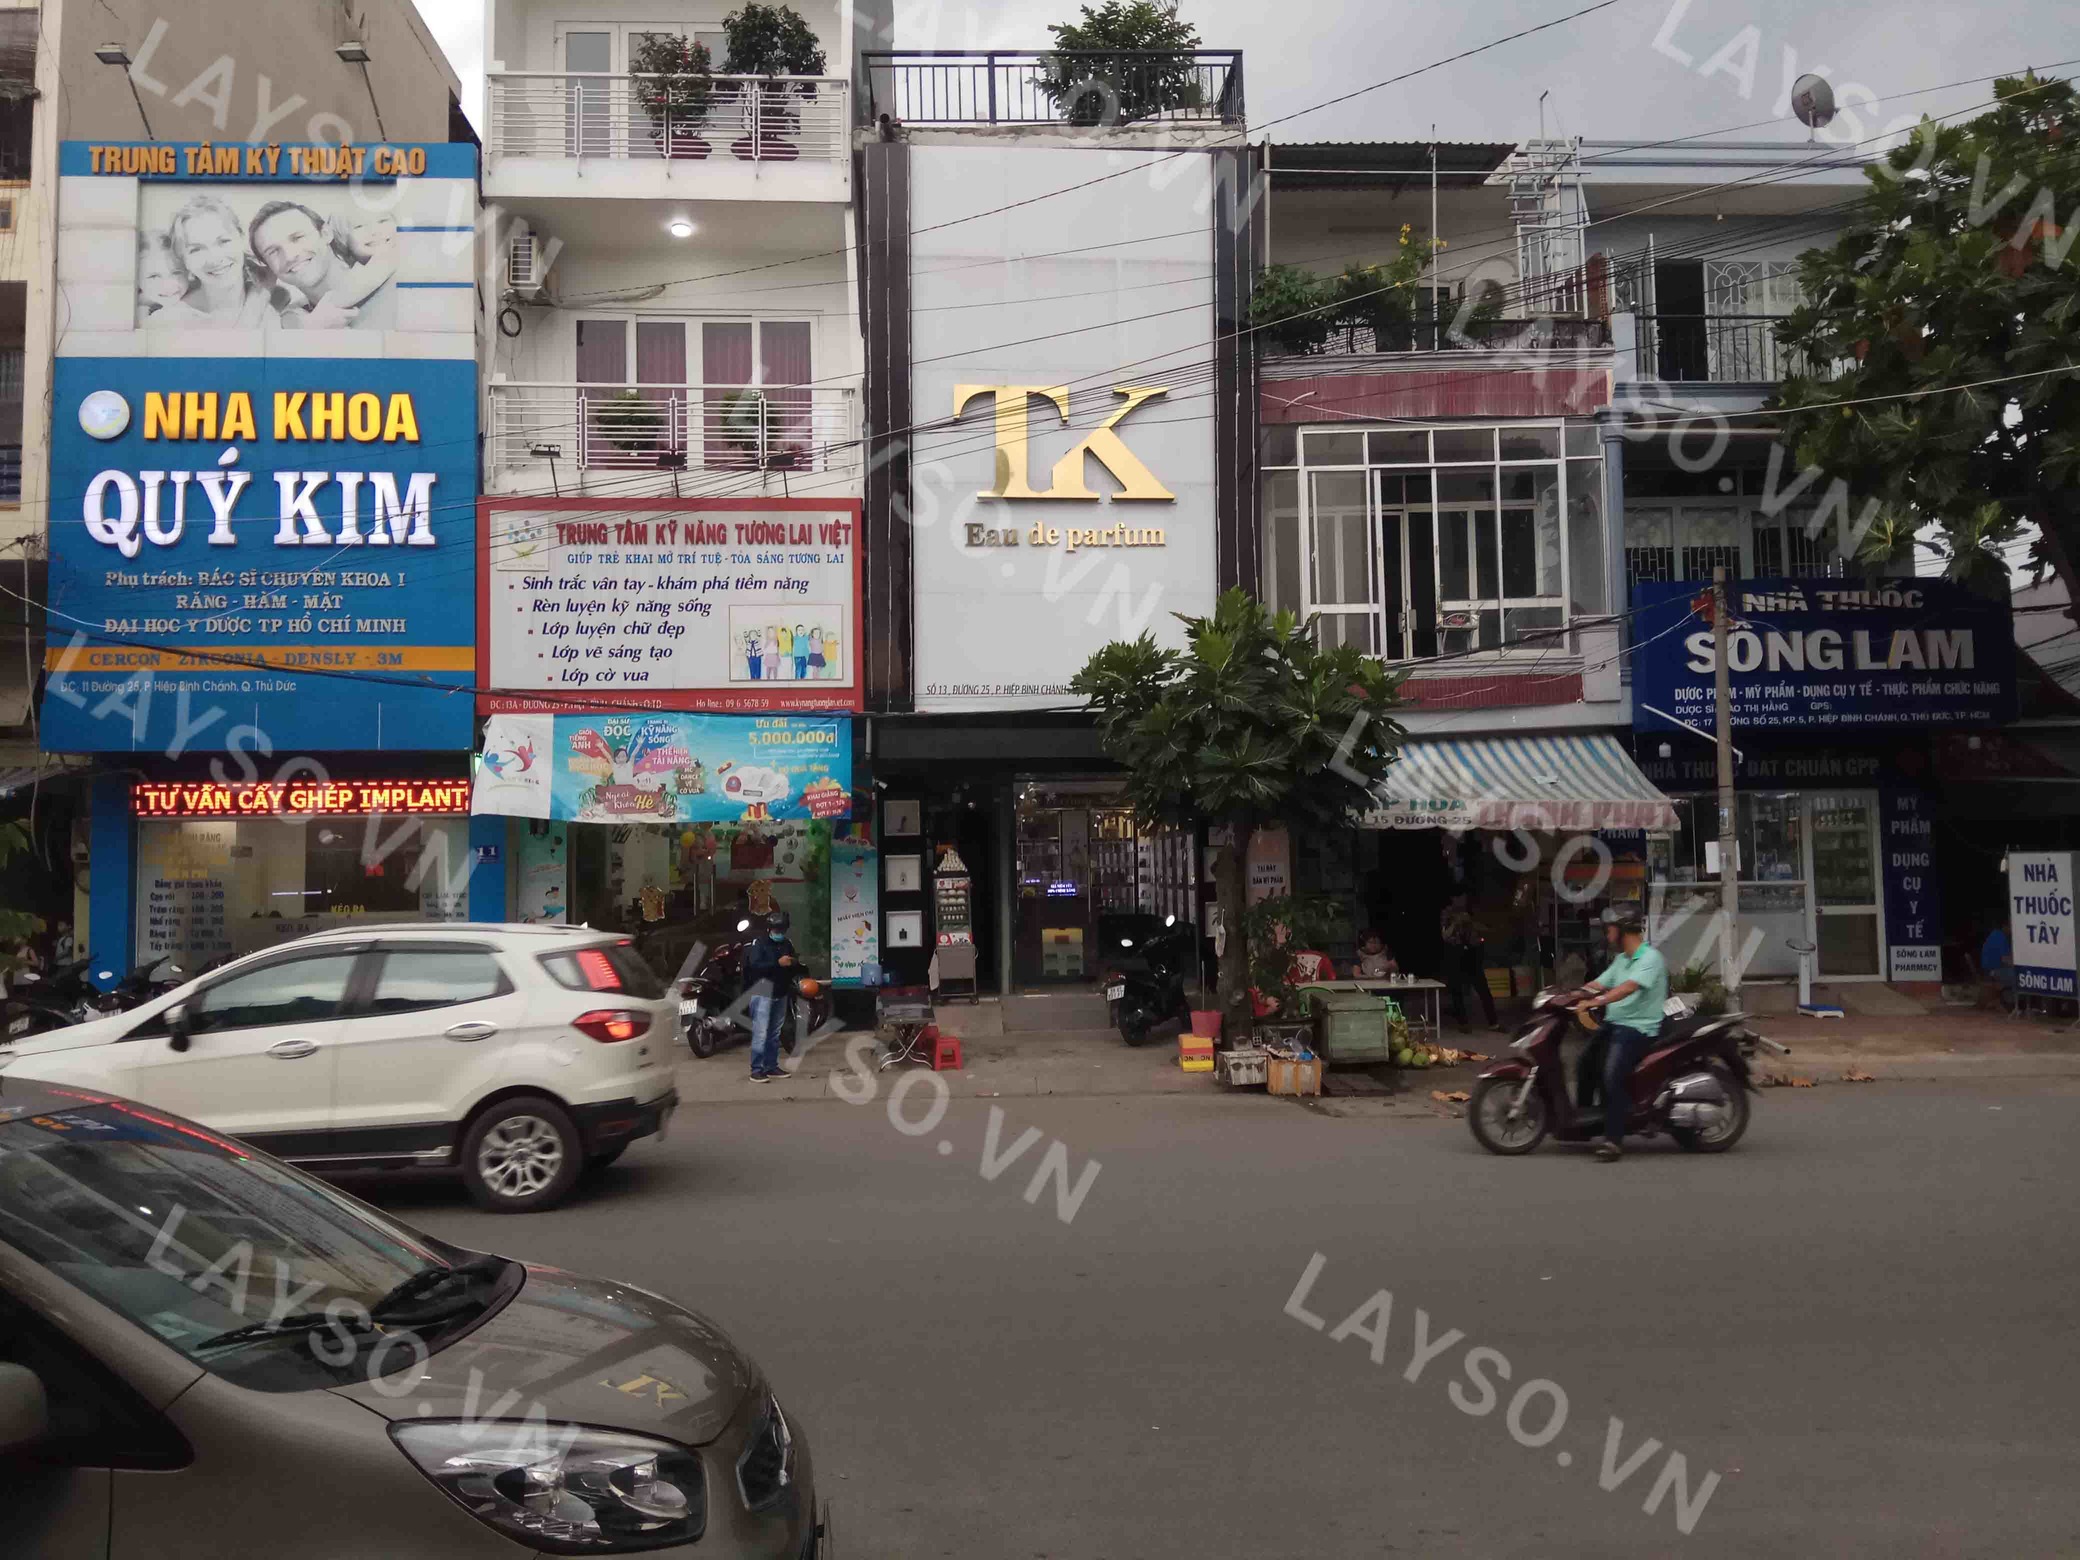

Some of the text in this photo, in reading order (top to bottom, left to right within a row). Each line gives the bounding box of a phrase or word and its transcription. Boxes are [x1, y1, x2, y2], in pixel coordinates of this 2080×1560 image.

[89, 142, 426, 180] TRUNG TÂM KỸ THUẬT CAO
[143, 392, 420, 440] NHA KHOA
[953, 384, 1176, 501] TK
[83, 447, 437, 559] QUÝ KIM
[556, 519, 852, 547] TRUNG TÂM KỸ NĂNG TƯƠNG LAI VIỆT
[964, 520, 1165, 552] Eau de parfum
[567, 549, 593, 565] GIÚP
[625, 553, 654, 565] KHAI
[678, 551, 698, 565] TRÍ
[701, 551, 723, 567] TUỆ
[756, 550, 784, 564] SÁNG
[788, 552, 821, 564] TƯƠNG
[826, 553, 845, 564] LAI
[105, 571, 138, 588] Phụ
[142, 571, 193, 587] trách:
[198, 567, 235, 586] BÁC
[261, 568, 337, 587] CHUYÊN
[341, 572, 392, 587] KHOA
[397, 573, 406, 587] I
[522, 572, 809, 595] Sinh trắc vân tay khám phá tiềm năng
[176, 593, 343, 611] RĂNG HÀM MẶT
[1743, 581, 1925, 612] NHÀ THUỐC
[532, 597, 712, 618] Rèn luyện kỹ năng sống
[105, 612, 407, 637] ĐẠI HỌC Y DƯỢC TP HỒ CHÍ MINH
[542, 619, 685, 641] Lớp luyện chữ đẹp
[552, 643, 673, 664] Lớp vẽ sáng tạo
[1685, 622, 1975, 672] SÔNG LAM
[89, 652, 161, 666] CERCON
[284, 652, 357, 666] DENSLY
[377, 652, 405, 665] 3M
[91, 679, 125, 695] Đường
[153, 680, 178, 694] Hiệp
[255, 678, 274, 692] Thủ
[561, 667, 649, 688] Lớp cờ vua
[1003, 684, 1020, 697] HIỆP
[1021, 683, 1040, 696] BÌNH
[1674, 683, 1704, 703] DƯỢC
[1745, 682, 1762, 698] MỸ
[1764, 680, 1796, 698] PHẨM
[1802, 684, 1831, 700] DỤNG
[1833, 684, 1848, 701] CỤ
[1848, 684, 1857, 697] Y
[1858, 680, 1873, 697] TẾ
[1675, 703, 1760, 716] DƯỢC THỊ
[1703, 718, 1712, 727] 17
[1752, 714, 1767, 727] SỐ
[604, 725, 632, 740] ĐỌC
[571, 741, 592, 750] ANH
[145, 786, 180, 810] TƯ
[290, 783, 354, 810] GHÉP
[360, 787, 467, 808] IMPLANT
[634, 793, 655, 810] Hè
[1891, 813, 1931, 836] PHẨM
[477, 846, 497, 857] 11
[1892, 852, 1930, 872] DỤNG
[2024, 857, 2059, 883] NHÀ
[1903, 876, 1922, 895] CỤ
[1908, 900, 1919, 915] Y
[2014, 888, 2073, 917] THUỐC
[1905, 918, 1924, 939] TẾ
[2027, 921, 2061, 946] TÂY
[1895, 963, 1938, 973] PHARMACY
[2019, 970, 2074, 993] SÔNG LAM
